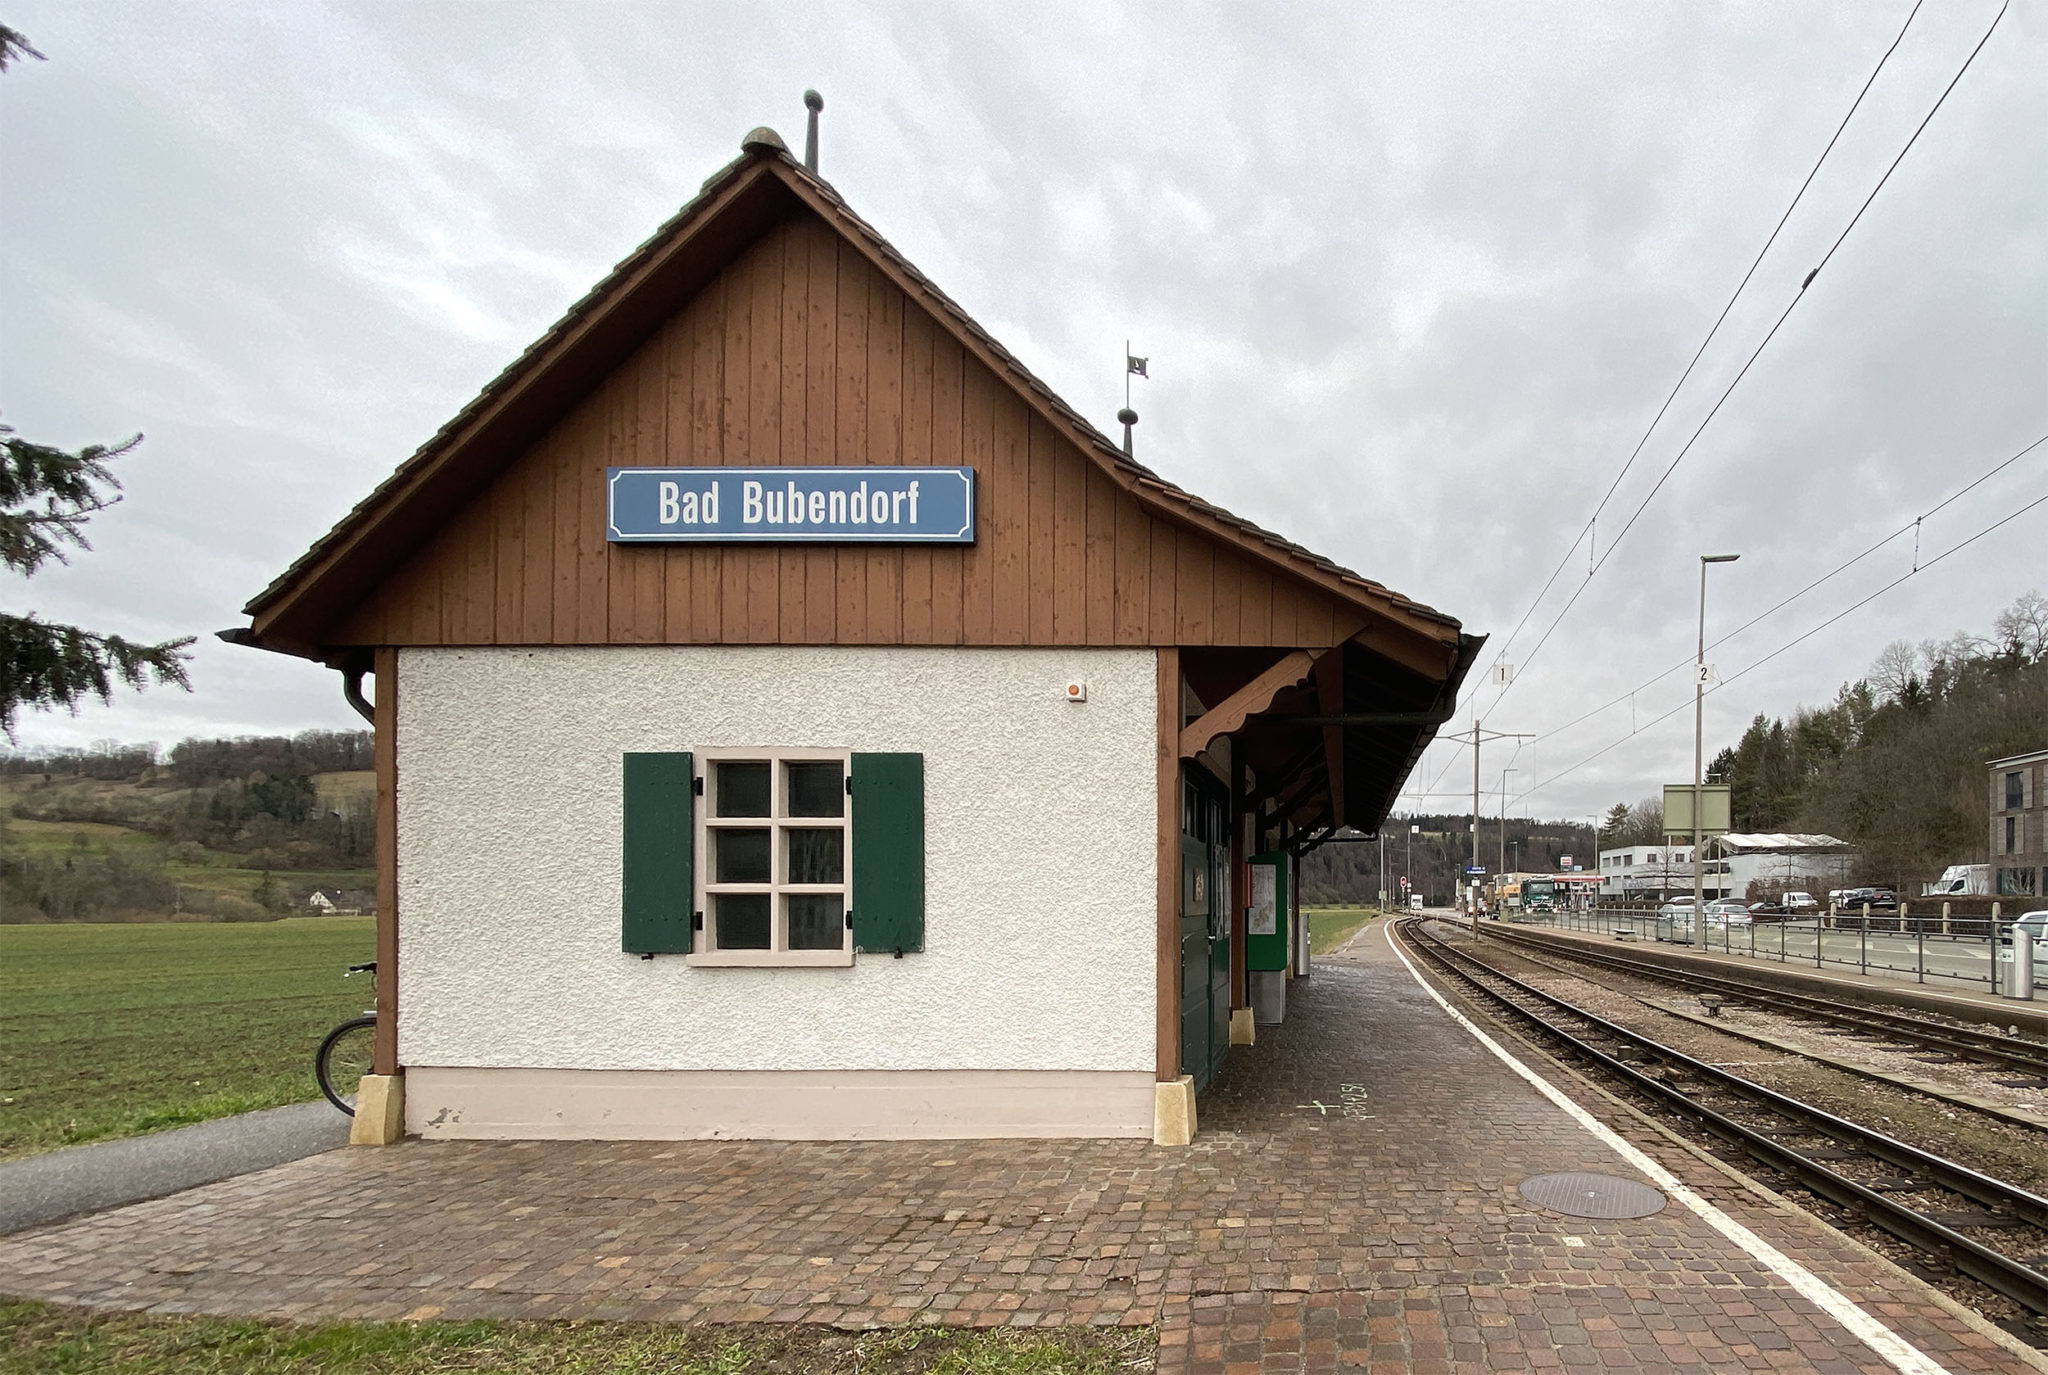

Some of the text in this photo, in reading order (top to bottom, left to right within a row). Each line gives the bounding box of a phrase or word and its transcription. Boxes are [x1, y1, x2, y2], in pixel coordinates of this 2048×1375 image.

[659, 480, 919, 524] Bad Bubendorf
[1700, 667, 1708, 681] 2
